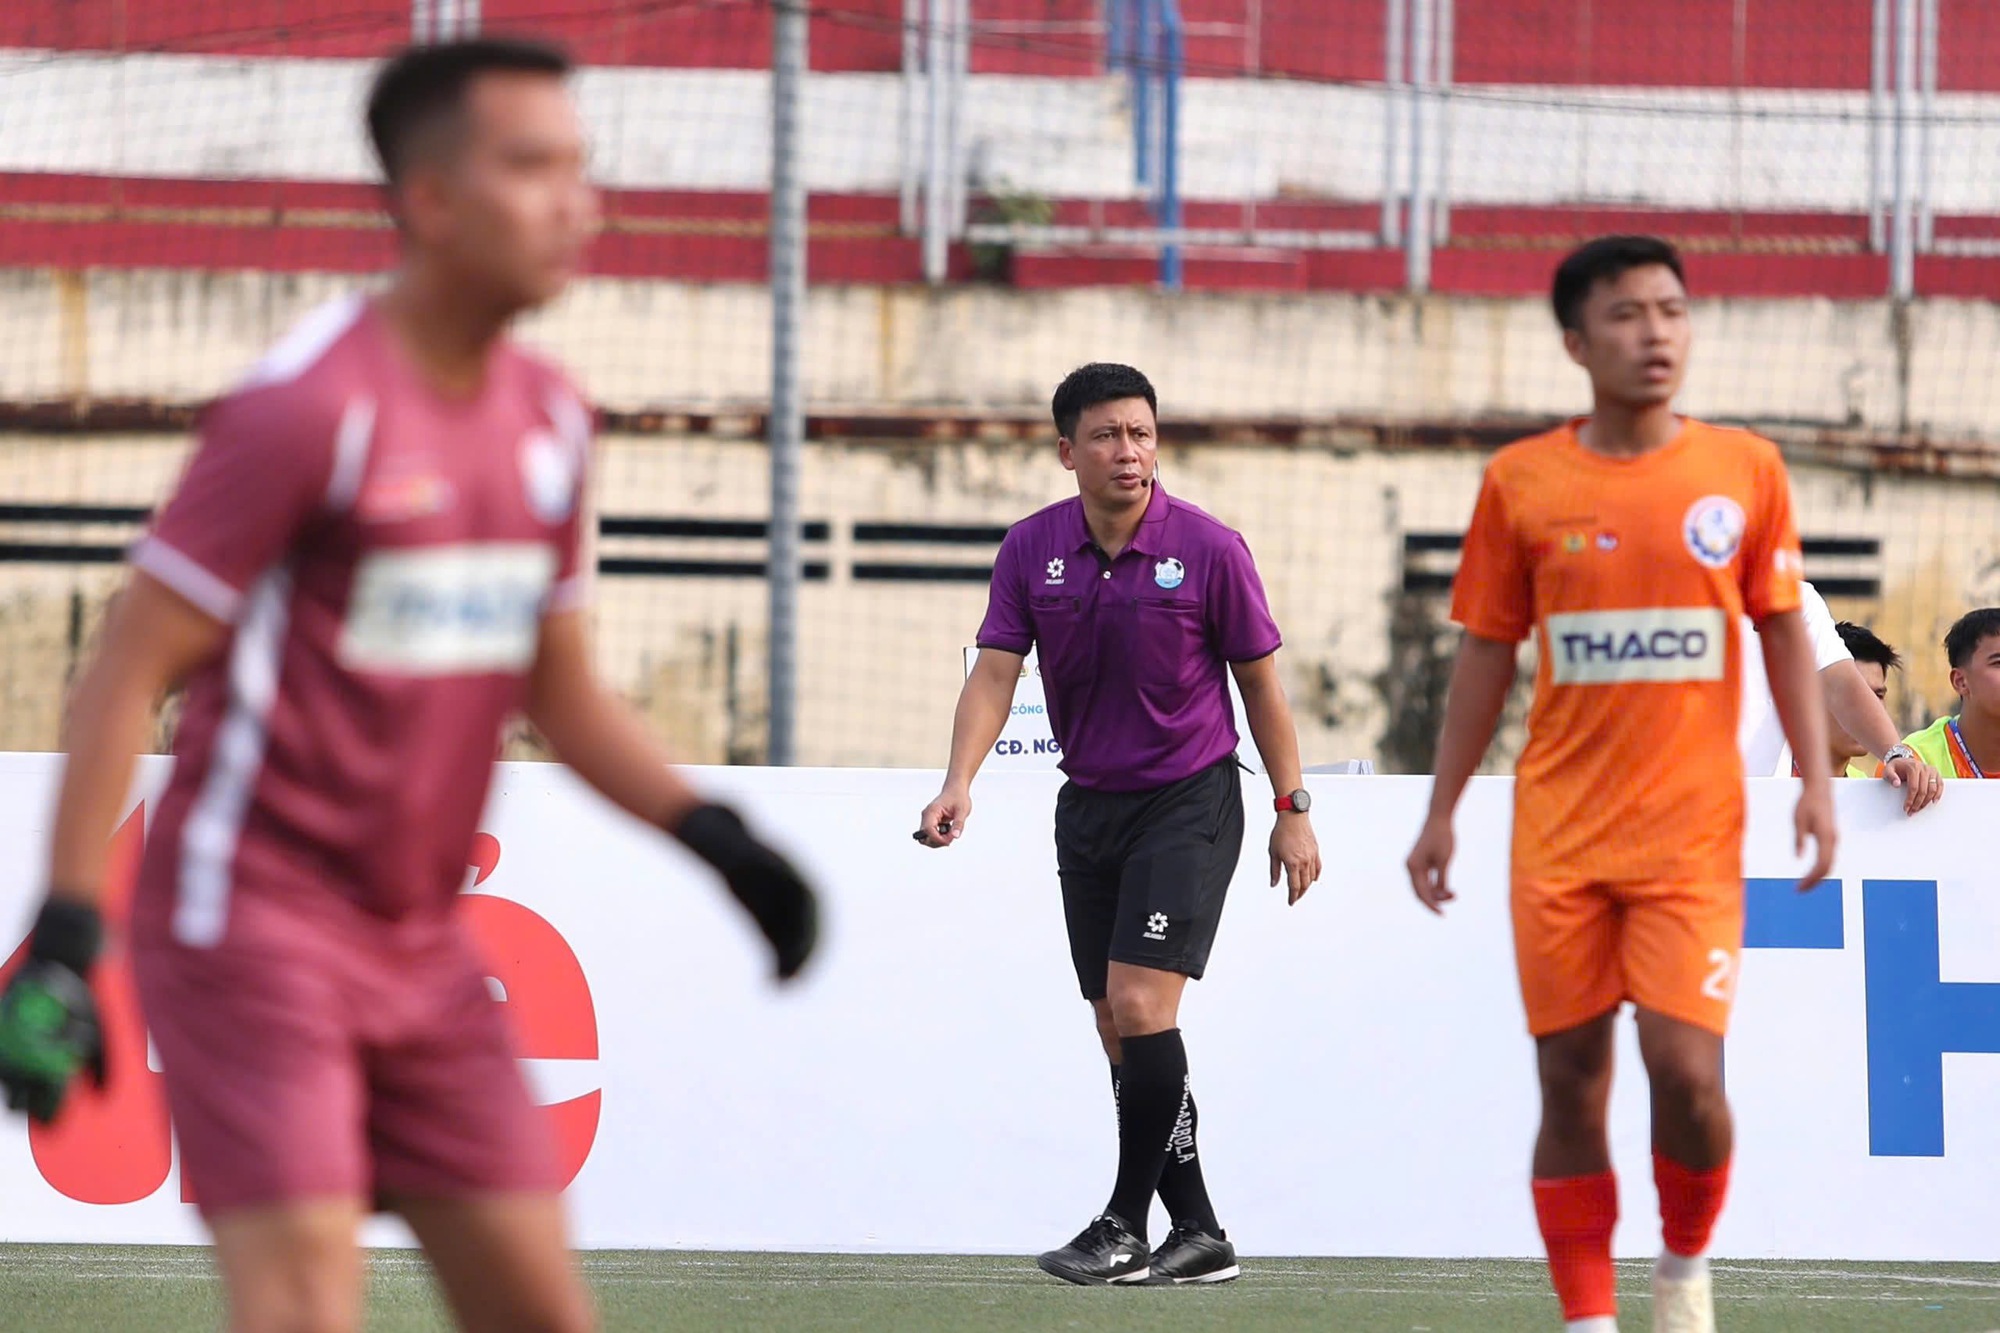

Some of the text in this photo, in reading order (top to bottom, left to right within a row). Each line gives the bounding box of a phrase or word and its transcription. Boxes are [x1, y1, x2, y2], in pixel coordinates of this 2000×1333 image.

[1560, 631, 1707, 664] THACO
[1011, 704, 1043, 714] CÔNG
[995, 740, 1028, 755] CĐ.
